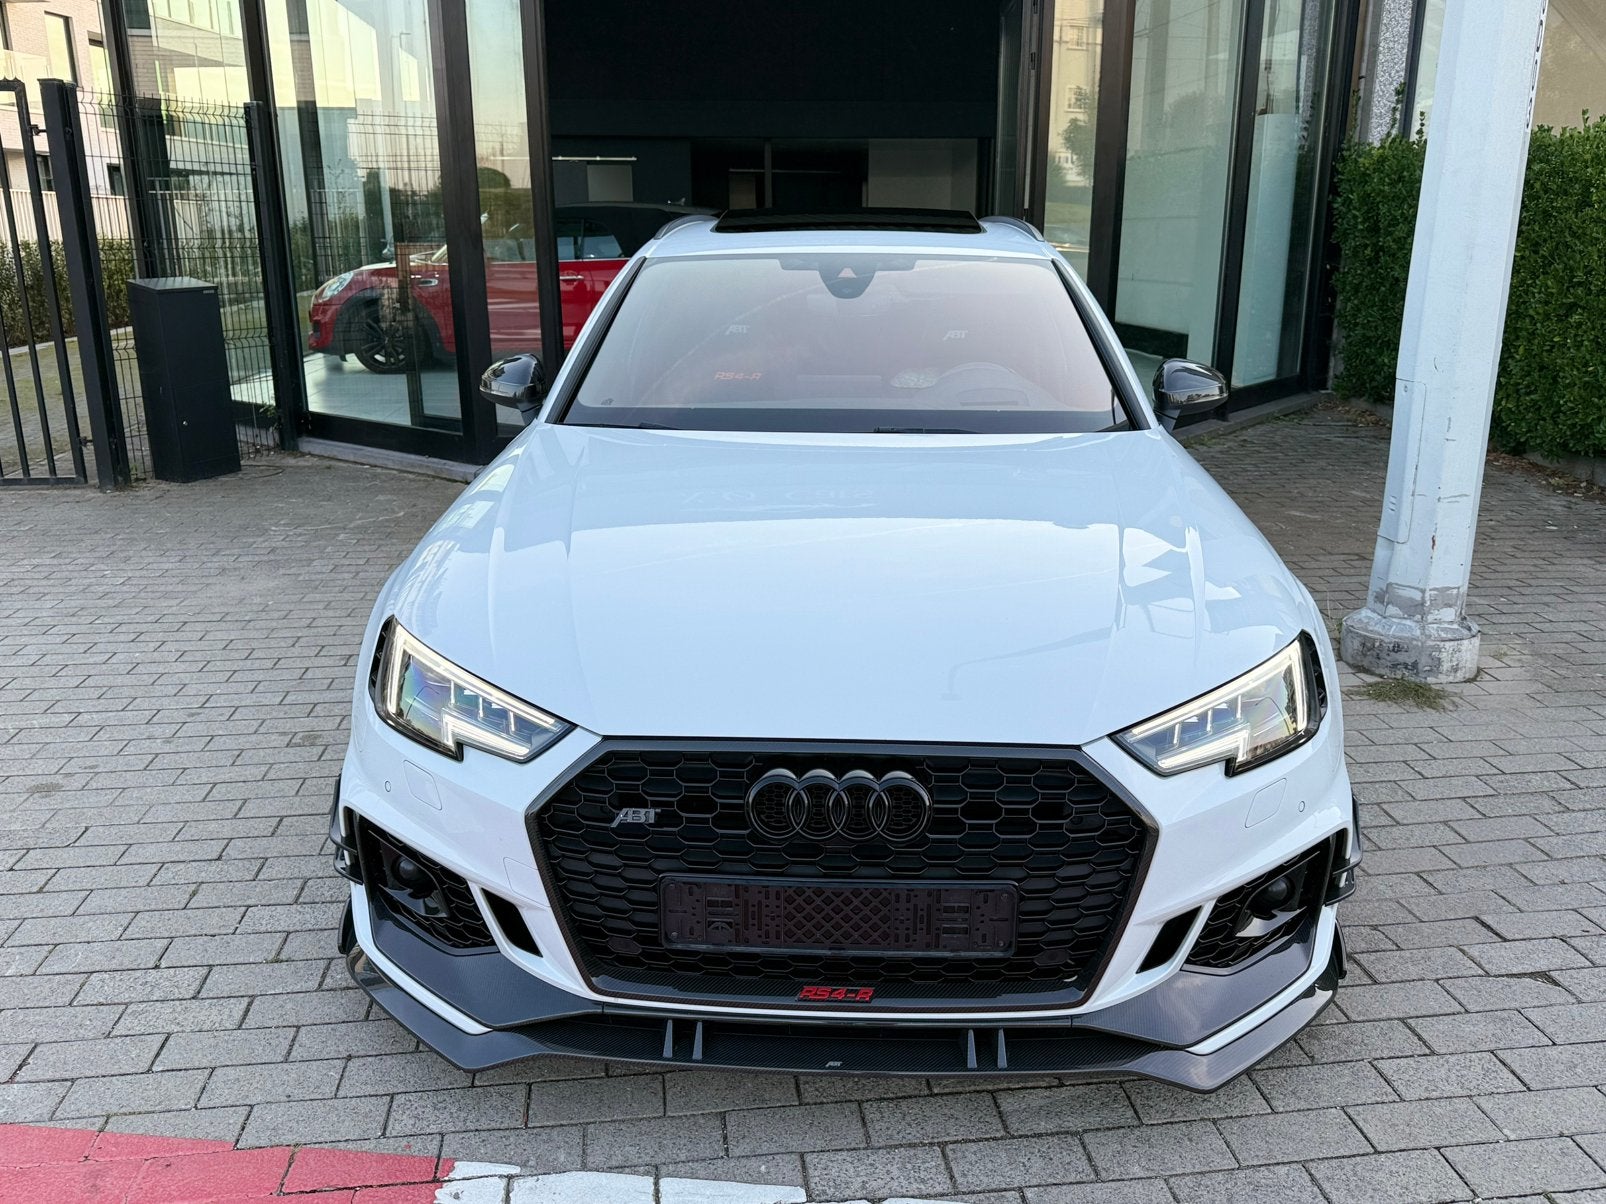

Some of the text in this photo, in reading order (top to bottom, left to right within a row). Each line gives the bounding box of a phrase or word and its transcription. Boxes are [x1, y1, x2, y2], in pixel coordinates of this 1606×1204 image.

[942, 330, 969, 341] ABT
[610, 808, 661, 828] ABT
[799, 986, 874, 1001] RS4-R
